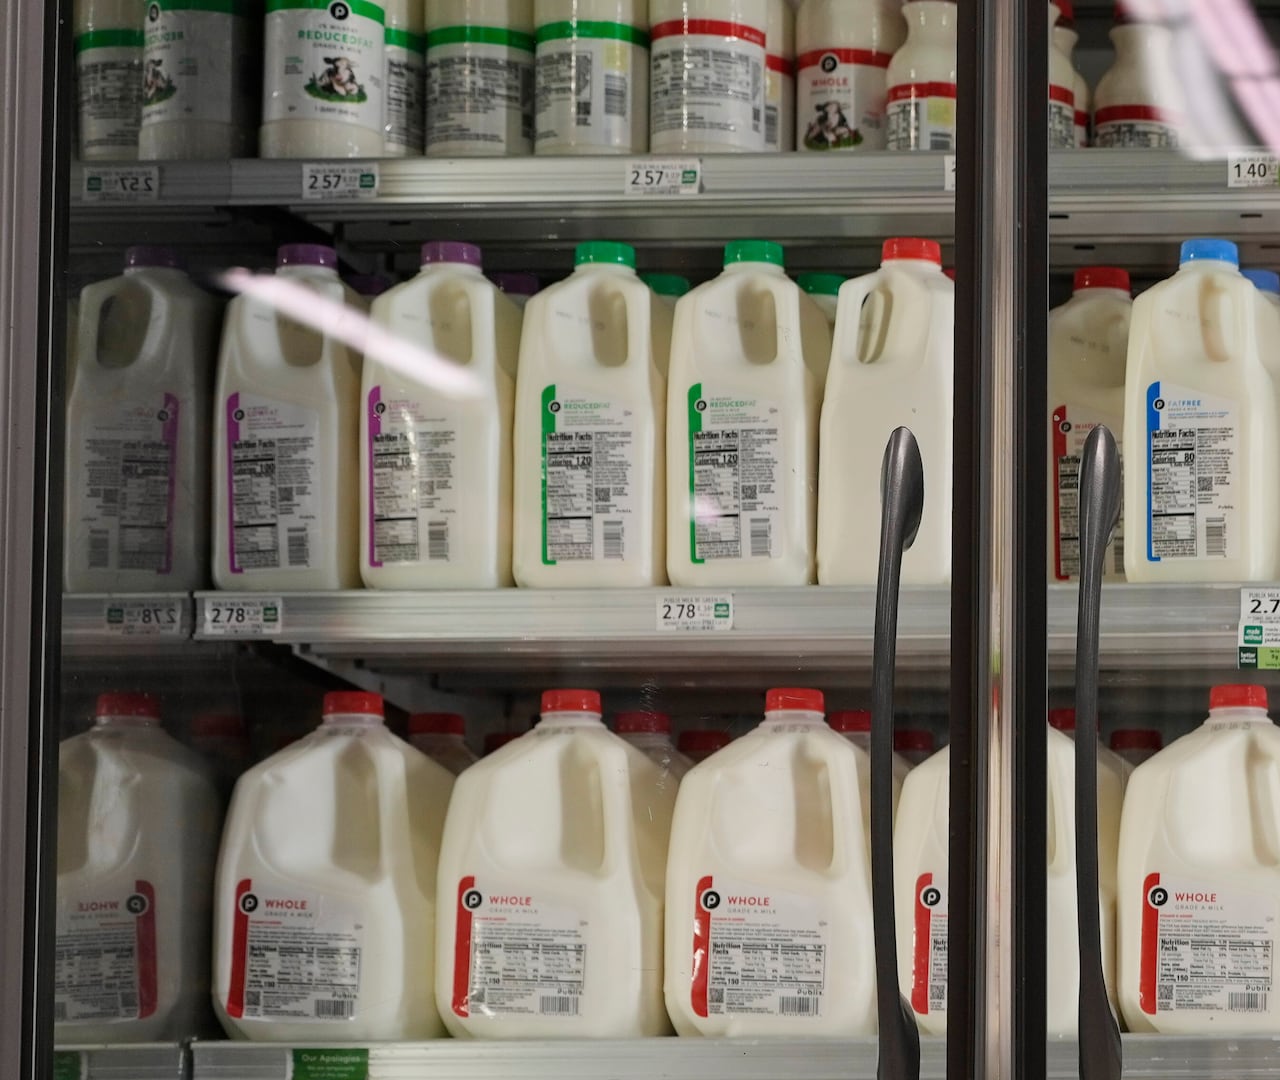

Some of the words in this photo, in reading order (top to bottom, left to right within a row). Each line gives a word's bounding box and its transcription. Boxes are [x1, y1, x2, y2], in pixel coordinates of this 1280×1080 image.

[811, 75, 849, 89] WHOLE
[1234, 163, 1267, 178] 1.40
[563, 400, 611, 411] REDUCEDFAT
[709, 399, 757, 409] REDUCEDFAT
[1167, 399, 1201, 408] FATFREE
[1152, 429, 1177, 439] Nutrition
[1178, 428, 1195, 438] Facts
[1184, 452, 1195, 462] 80
[211, 608, 245, 623] 2.78
[662, 603, 696, 619] 2.78
[489, 895, 532, 906] WHOLE
[727, 896, 770, 906] WHOLE
[1175, 893, 1217, 902] WHOLE
[265, 899, 307, 910] WHOLE
